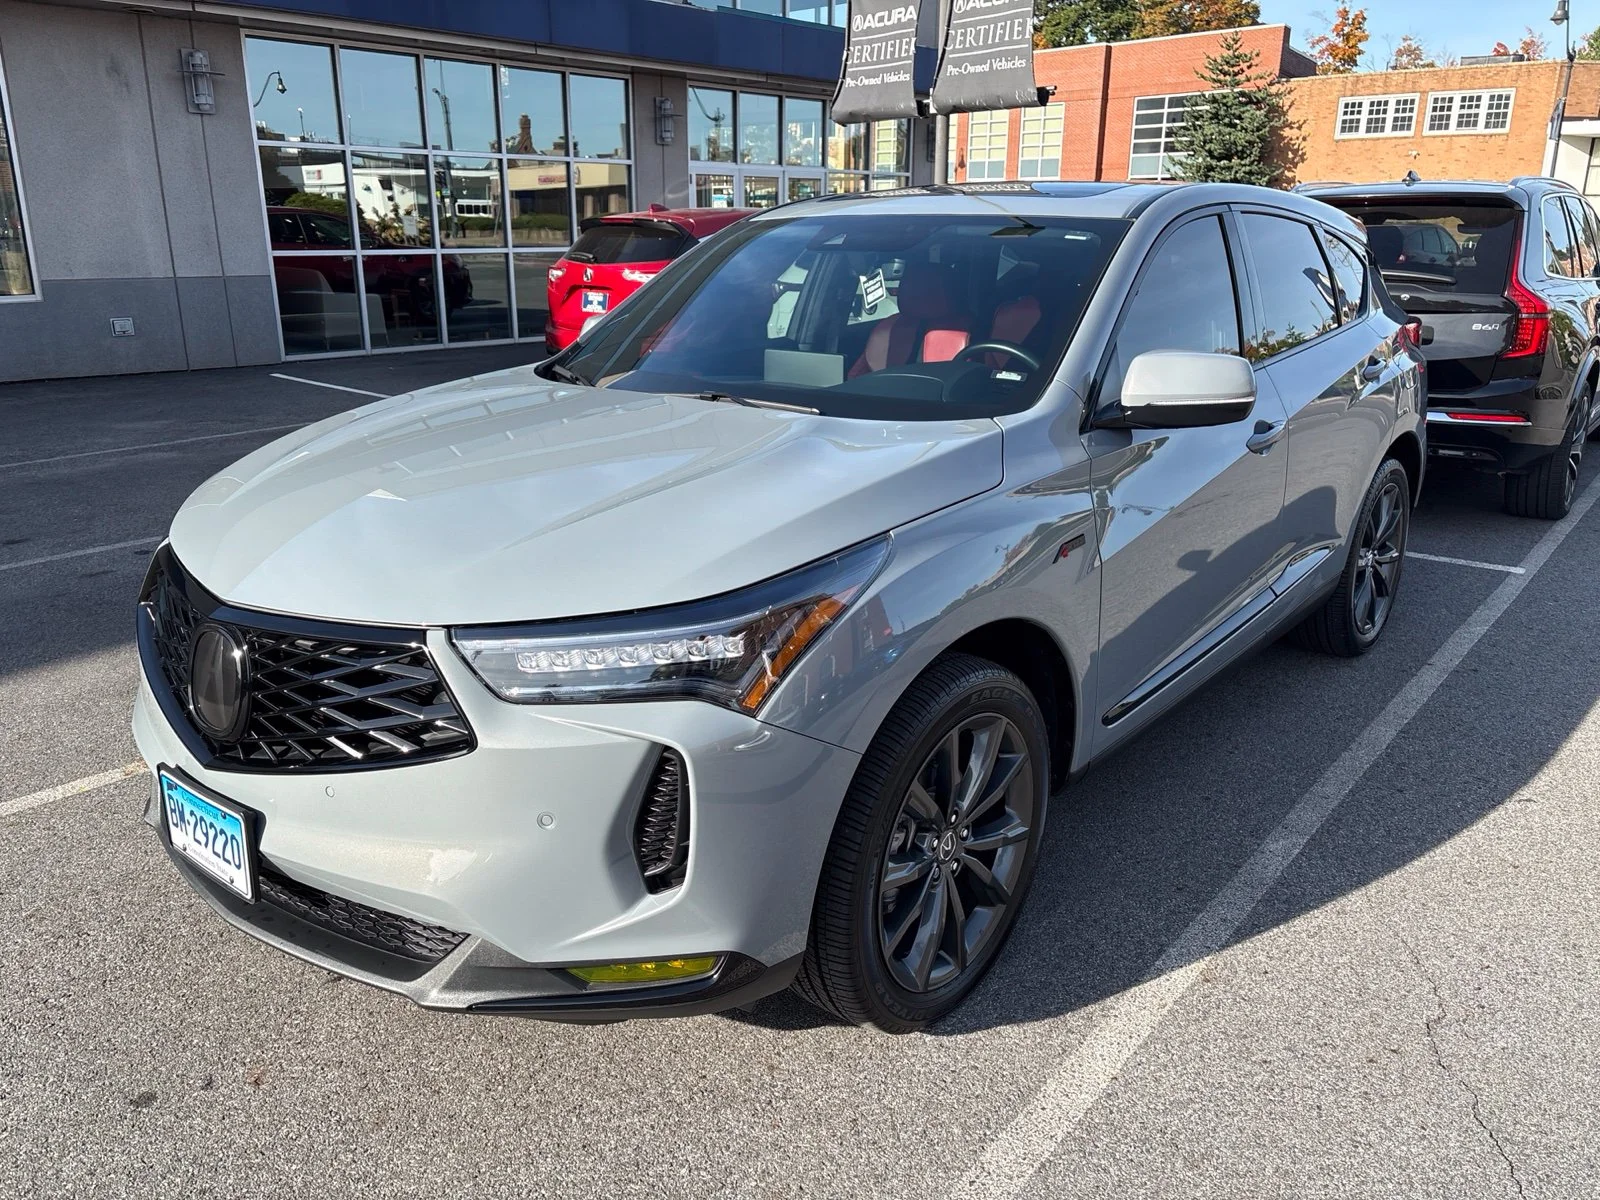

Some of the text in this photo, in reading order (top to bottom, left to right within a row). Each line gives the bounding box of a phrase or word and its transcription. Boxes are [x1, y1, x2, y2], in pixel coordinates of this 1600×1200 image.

[863, 5, 917, 30] ACURA
[946, 55, 1027, 76] Pre-Owned Vehicles
[845, 70, 910, 88] Pre-Owned Vehicles
[181, 790, 220, 821] Connecticut
